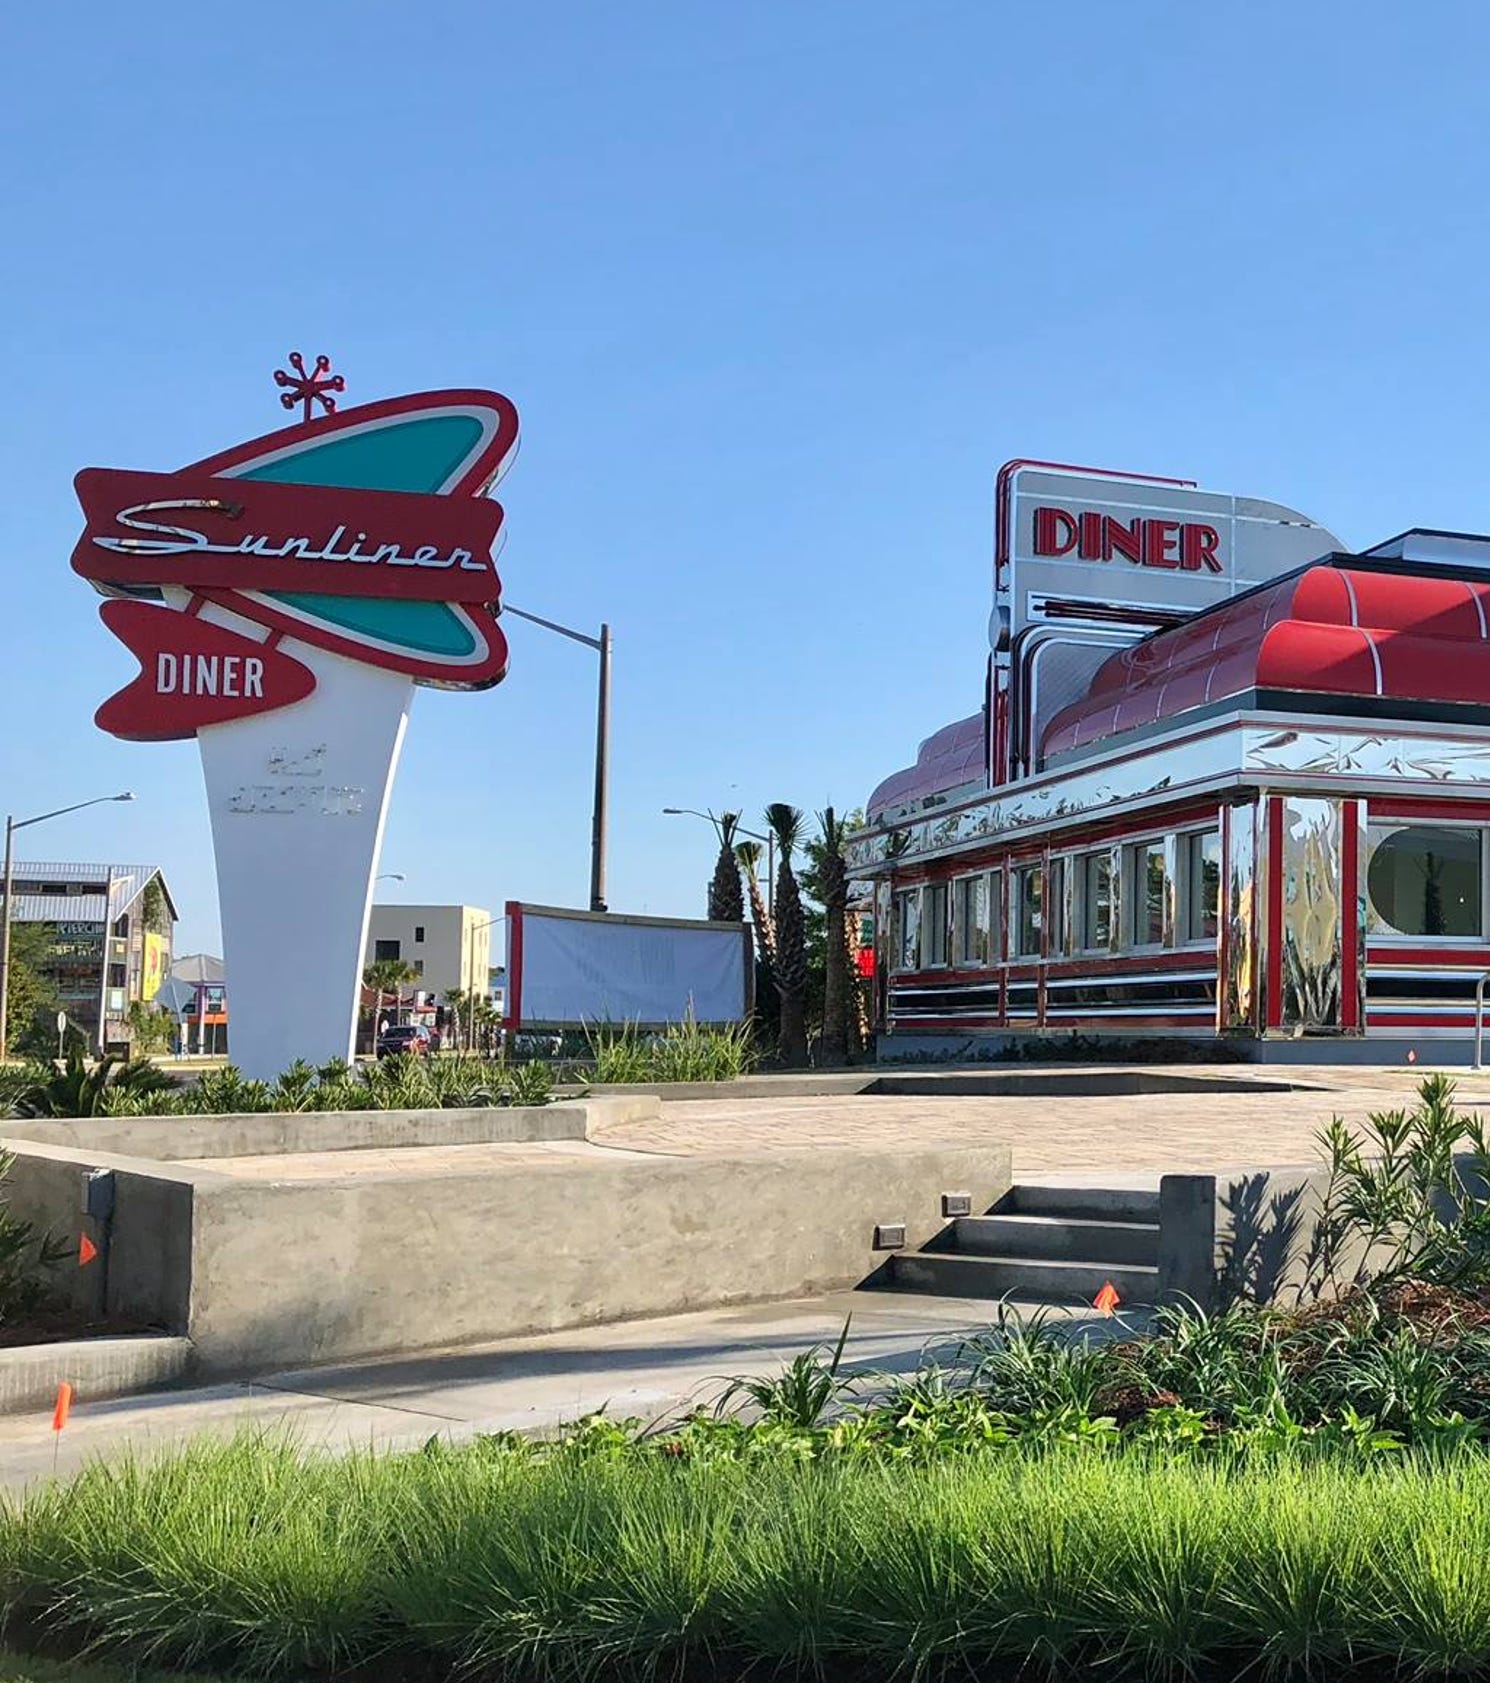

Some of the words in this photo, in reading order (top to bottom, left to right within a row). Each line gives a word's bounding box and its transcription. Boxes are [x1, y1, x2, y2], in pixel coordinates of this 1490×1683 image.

[92, 498, 488, 571] Sunliner
[1033, 506, 1224, 573] DINER
[156, 652, 264, 699] DINER
